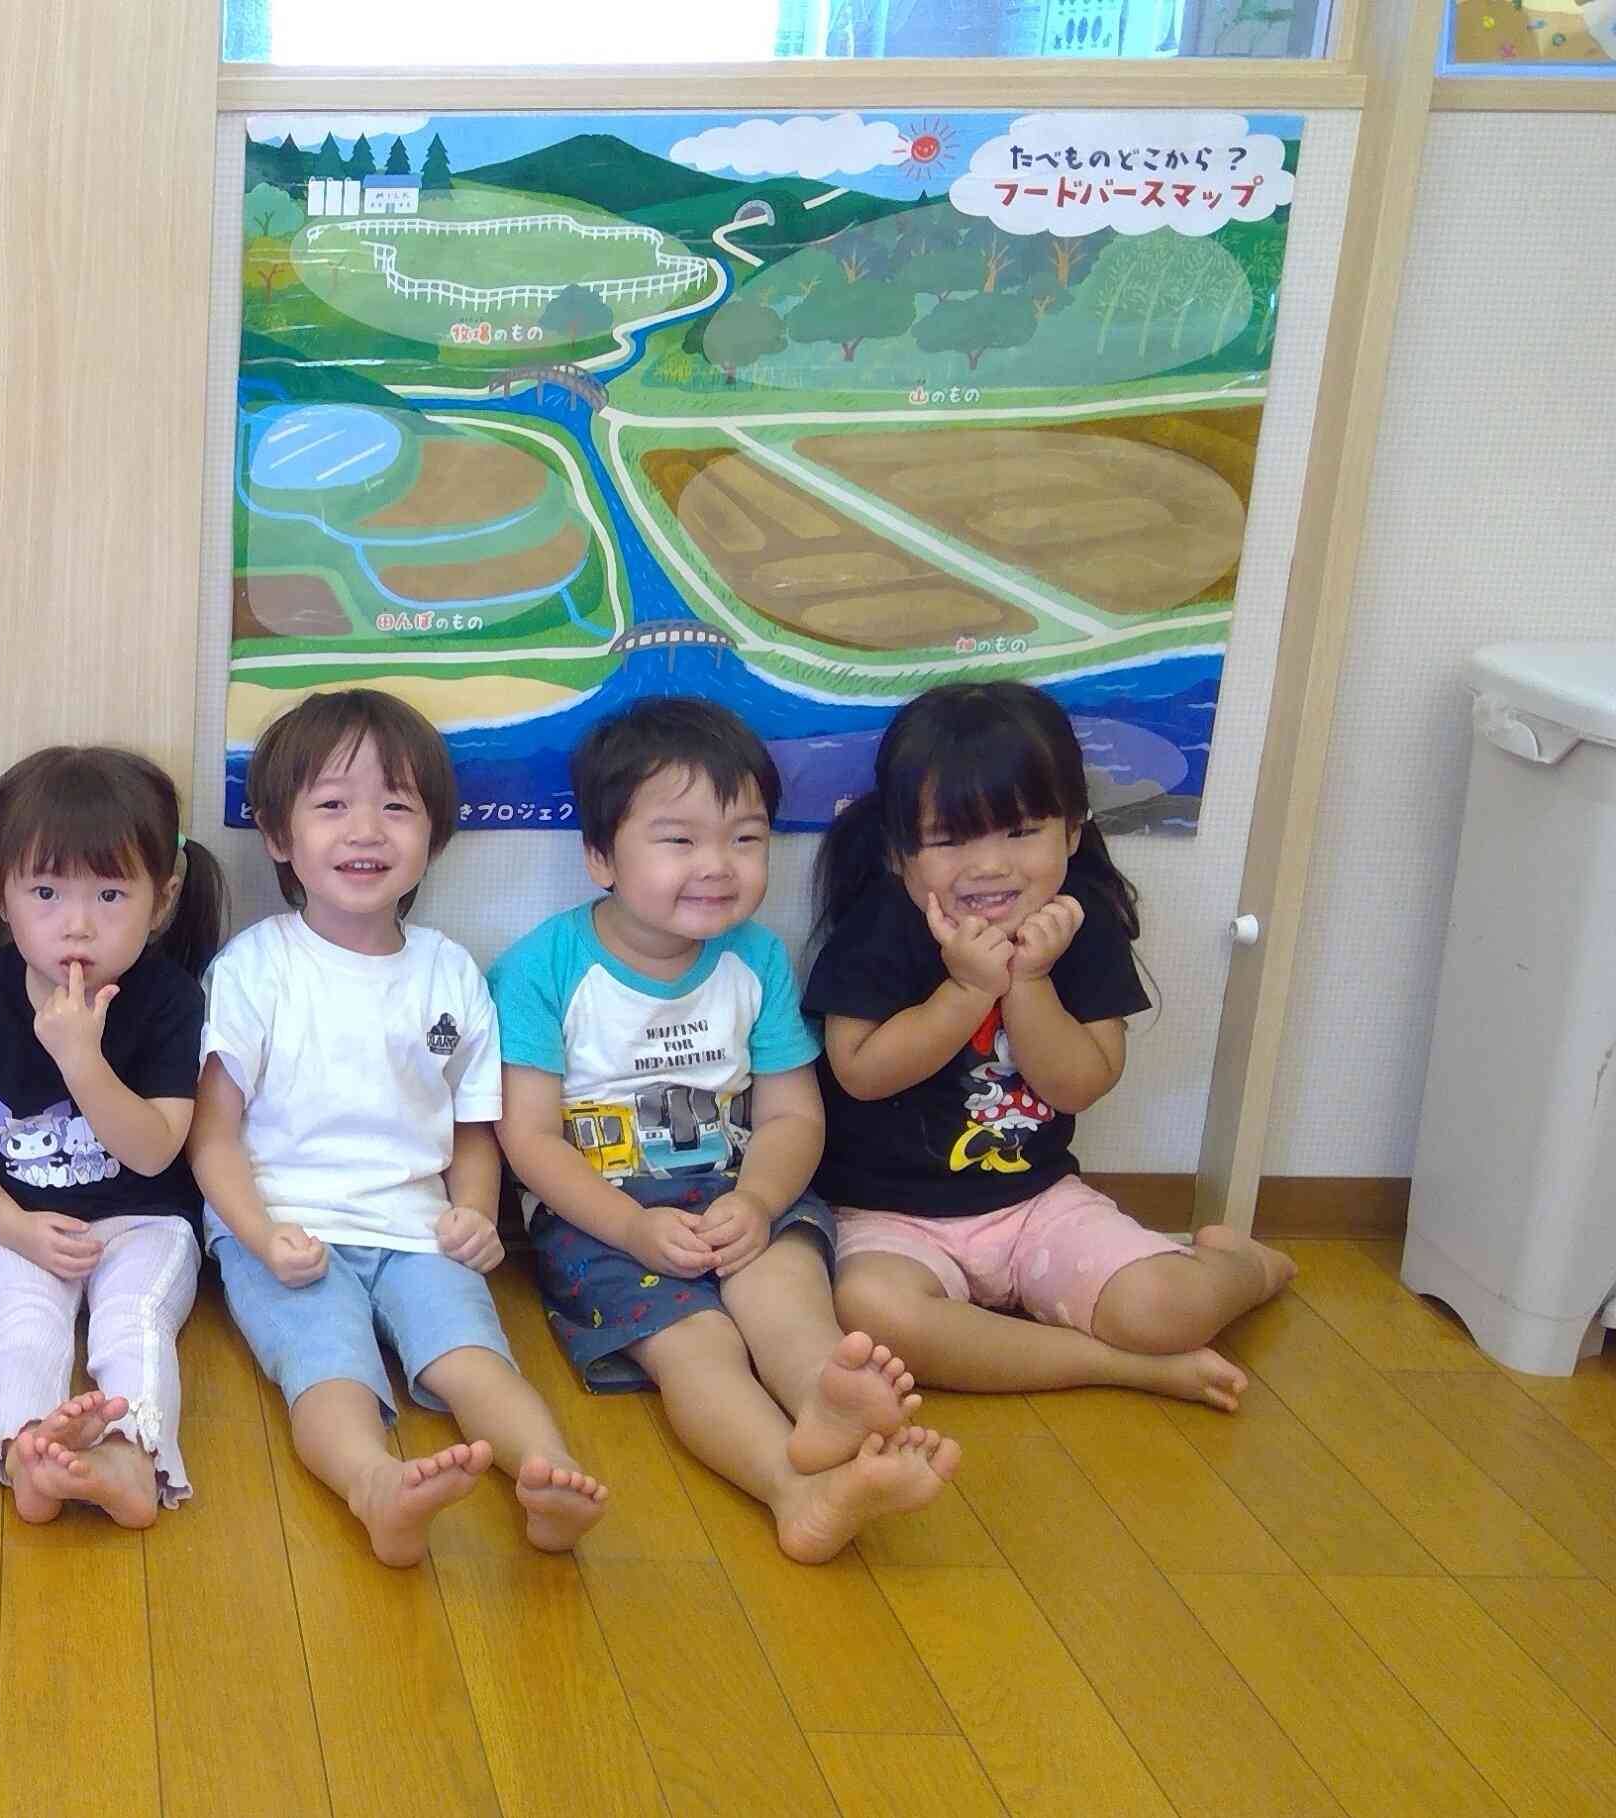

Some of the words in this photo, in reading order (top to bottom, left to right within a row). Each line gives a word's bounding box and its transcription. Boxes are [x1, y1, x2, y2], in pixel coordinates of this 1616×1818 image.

[994, 175, 1264, 209] フードバースマップ
[909, 386, 981, 404] 山のもの
[376, 610, 484, 631] 田んぼのもの
[646, 1019, 709, 1040] WAITING
[664, 1038, 694, 1053] FOR
[635, 1048, 727, 1071] DEPARTURE
